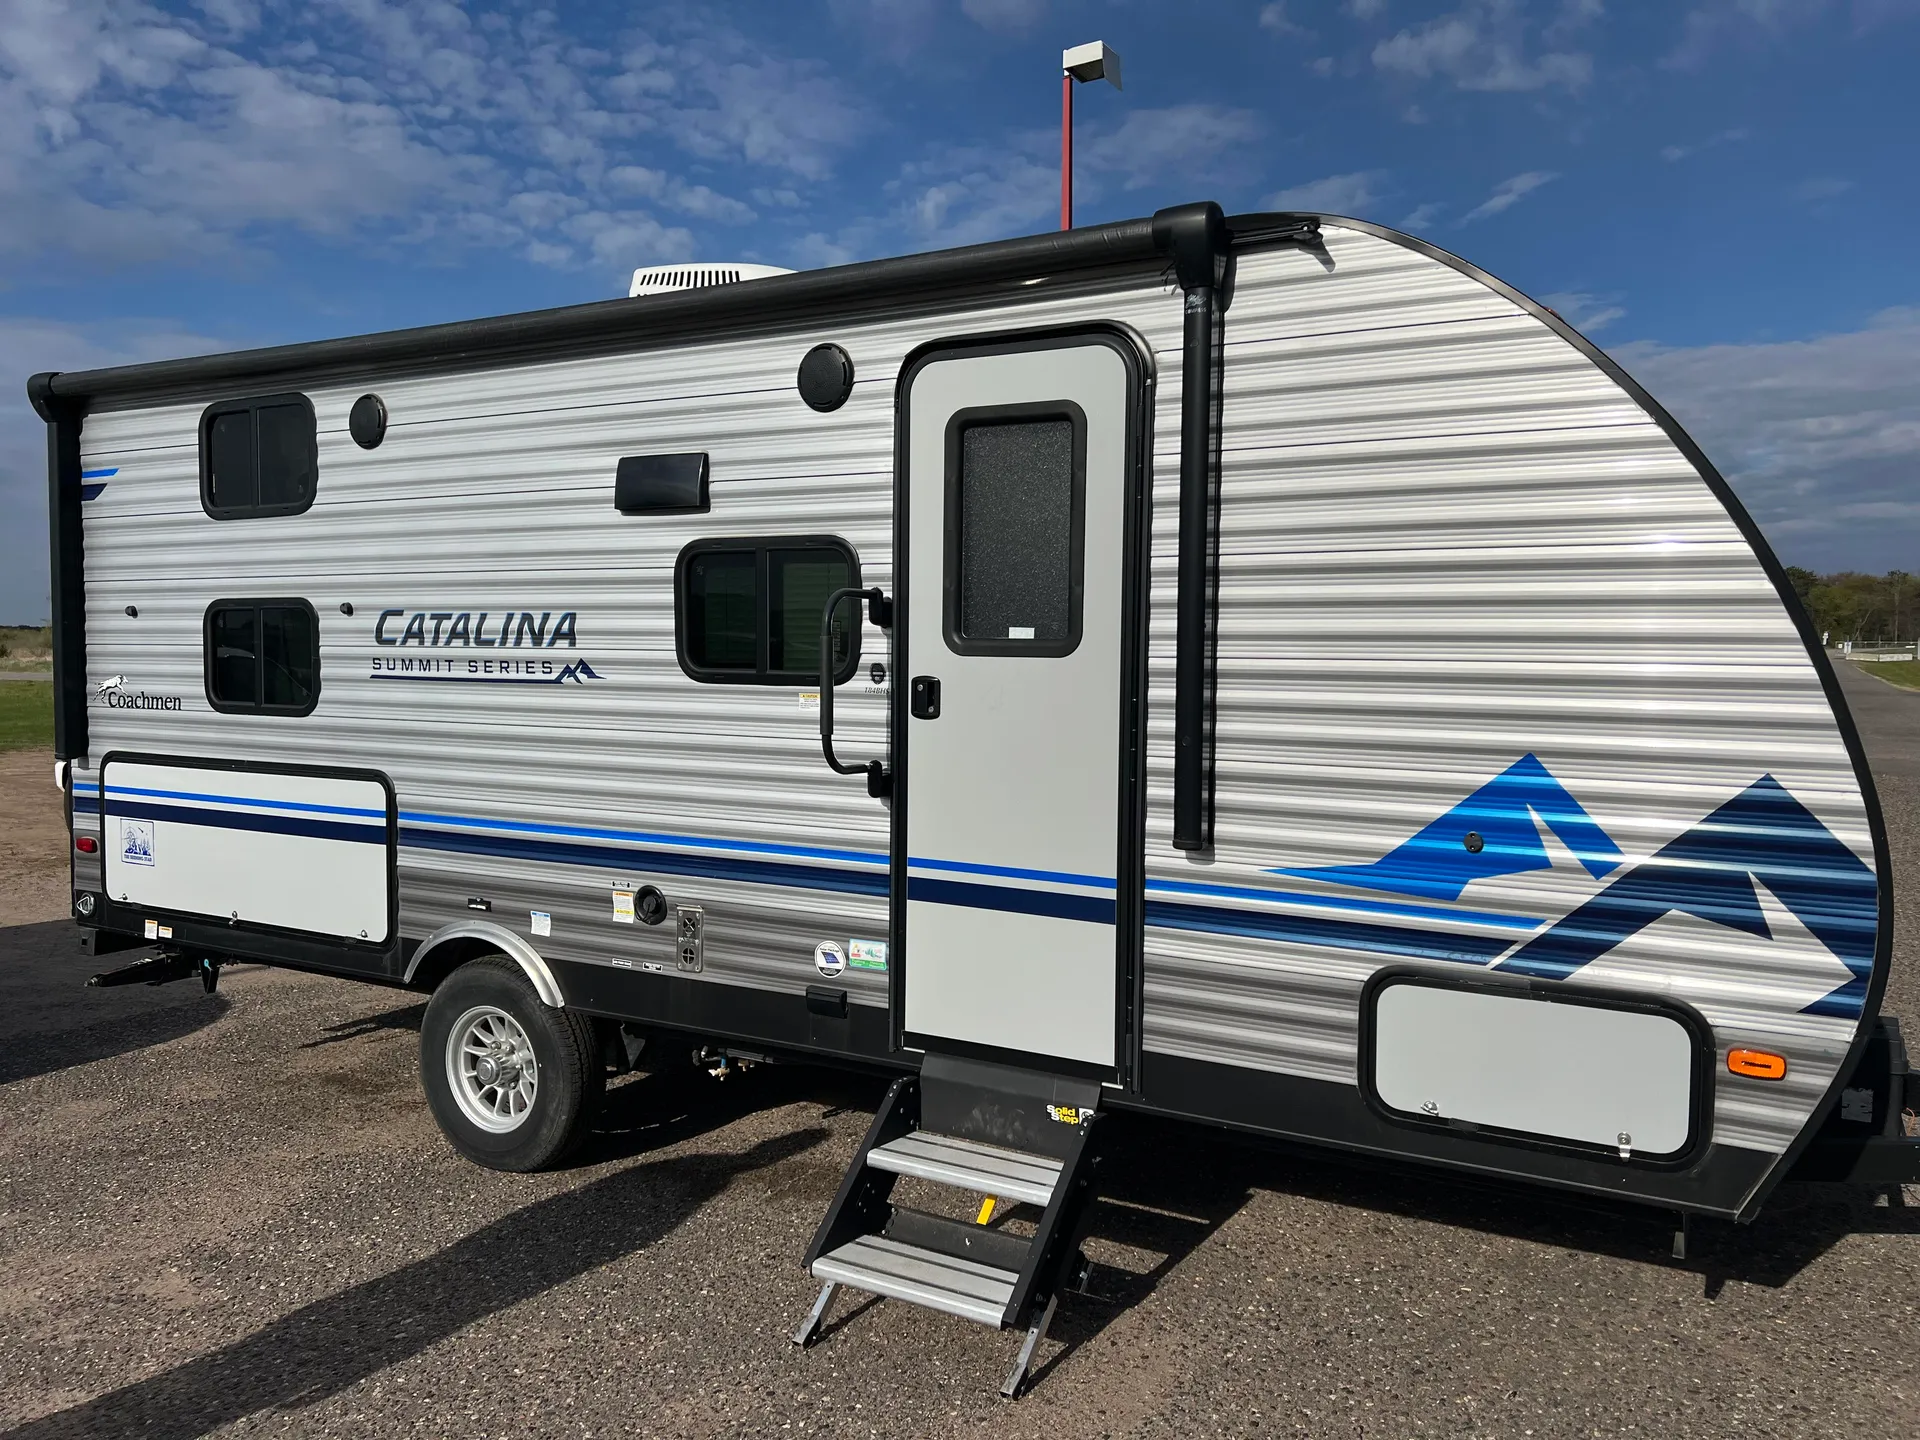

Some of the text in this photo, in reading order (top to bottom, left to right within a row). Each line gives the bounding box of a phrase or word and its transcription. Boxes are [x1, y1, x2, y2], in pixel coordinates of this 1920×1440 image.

[374, 609, 577, 648] CATALINA
[372, 657, 553, 675] SUMMIT SERIES
[108, 690, 182, 711] Coachmen
[1046, 1104, 1076, 1117] Solid
[1050, 1111, 1079, 1125] Step
